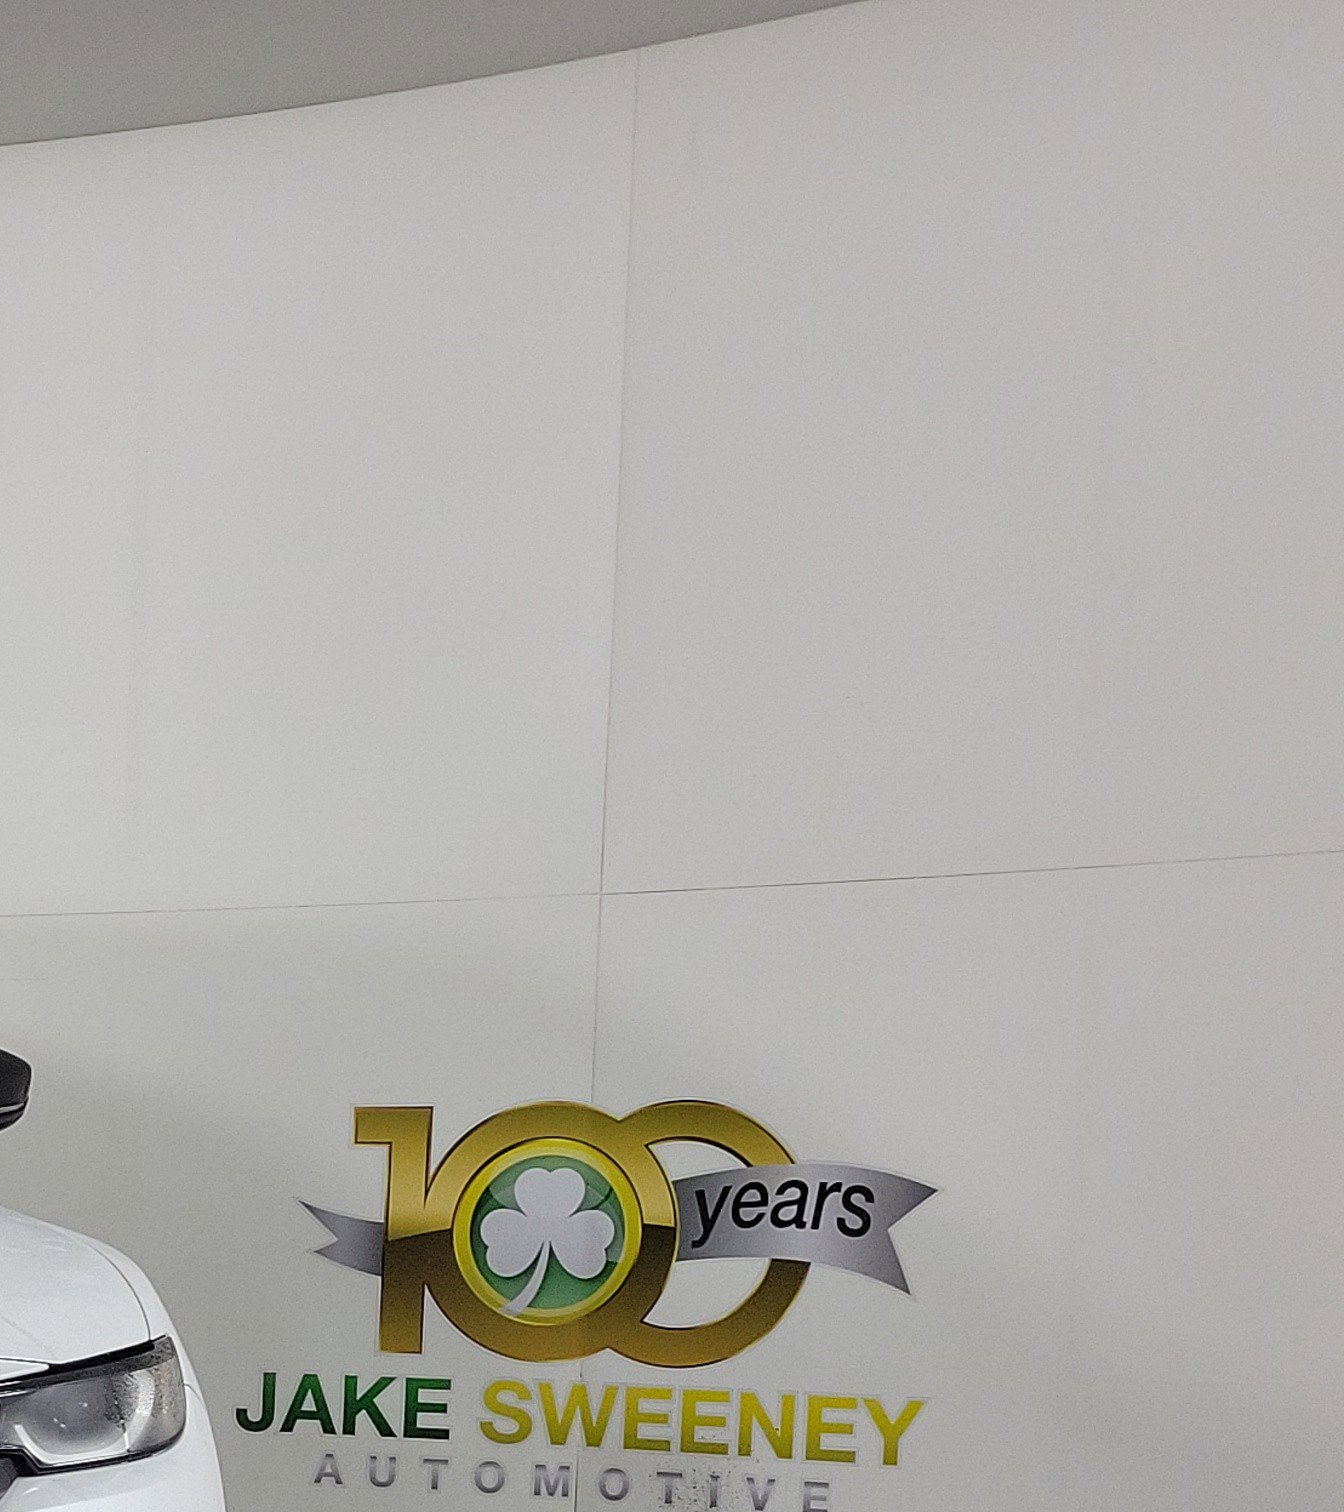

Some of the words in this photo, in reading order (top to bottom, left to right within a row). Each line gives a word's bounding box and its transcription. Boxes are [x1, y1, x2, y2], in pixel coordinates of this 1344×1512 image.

[354, 1100, 811, 1369] 100
[690, 1178, 874, 1251] years
[235, 1371, 452, 1441] JAKE
[479, 1378, 925, 1467] SWEENEY
